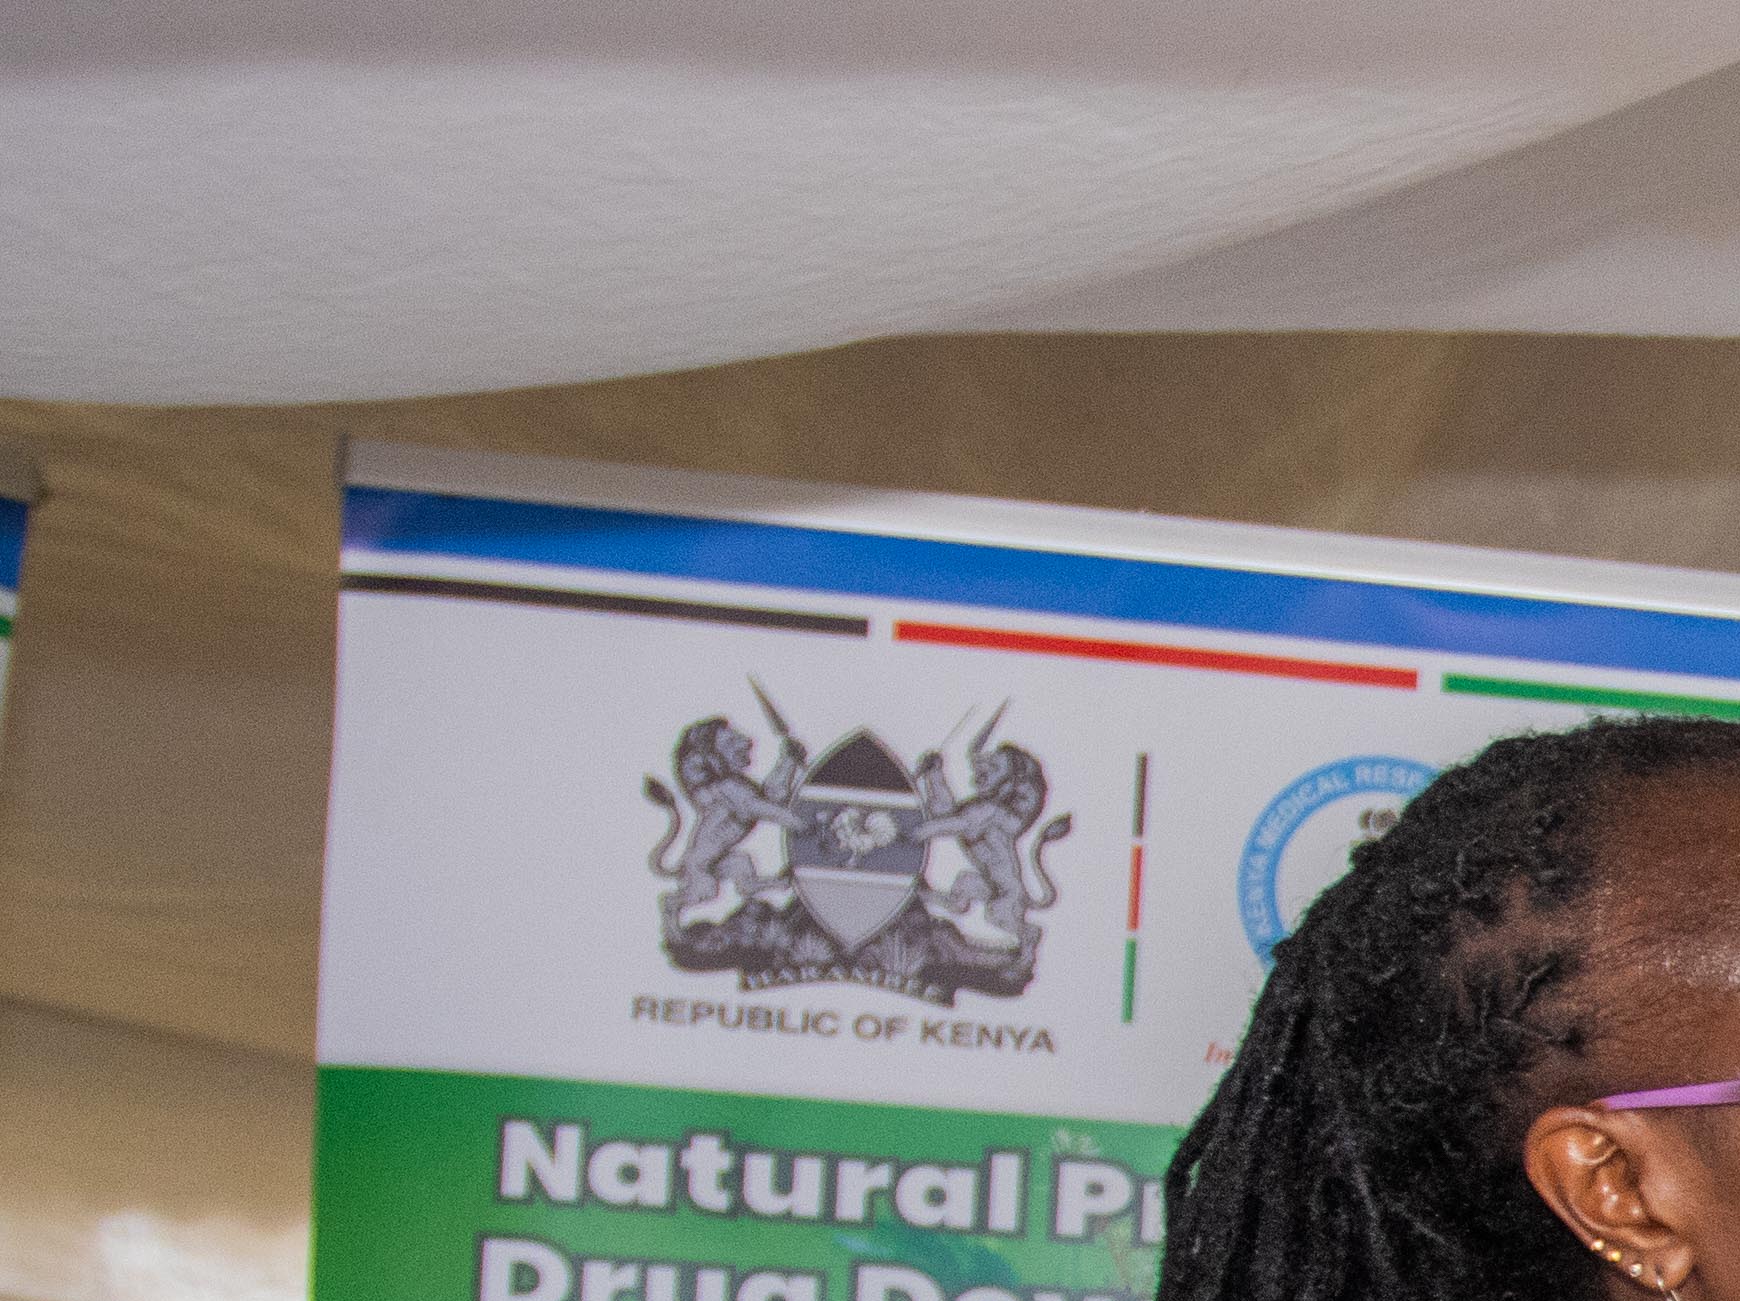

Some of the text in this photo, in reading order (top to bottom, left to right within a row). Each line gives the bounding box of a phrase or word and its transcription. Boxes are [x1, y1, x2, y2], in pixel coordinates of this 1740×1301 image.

[631, 996, 1056, 1053] REPUBLIC OF KENYA
[499, 1122, 1021, 1242] Natural
